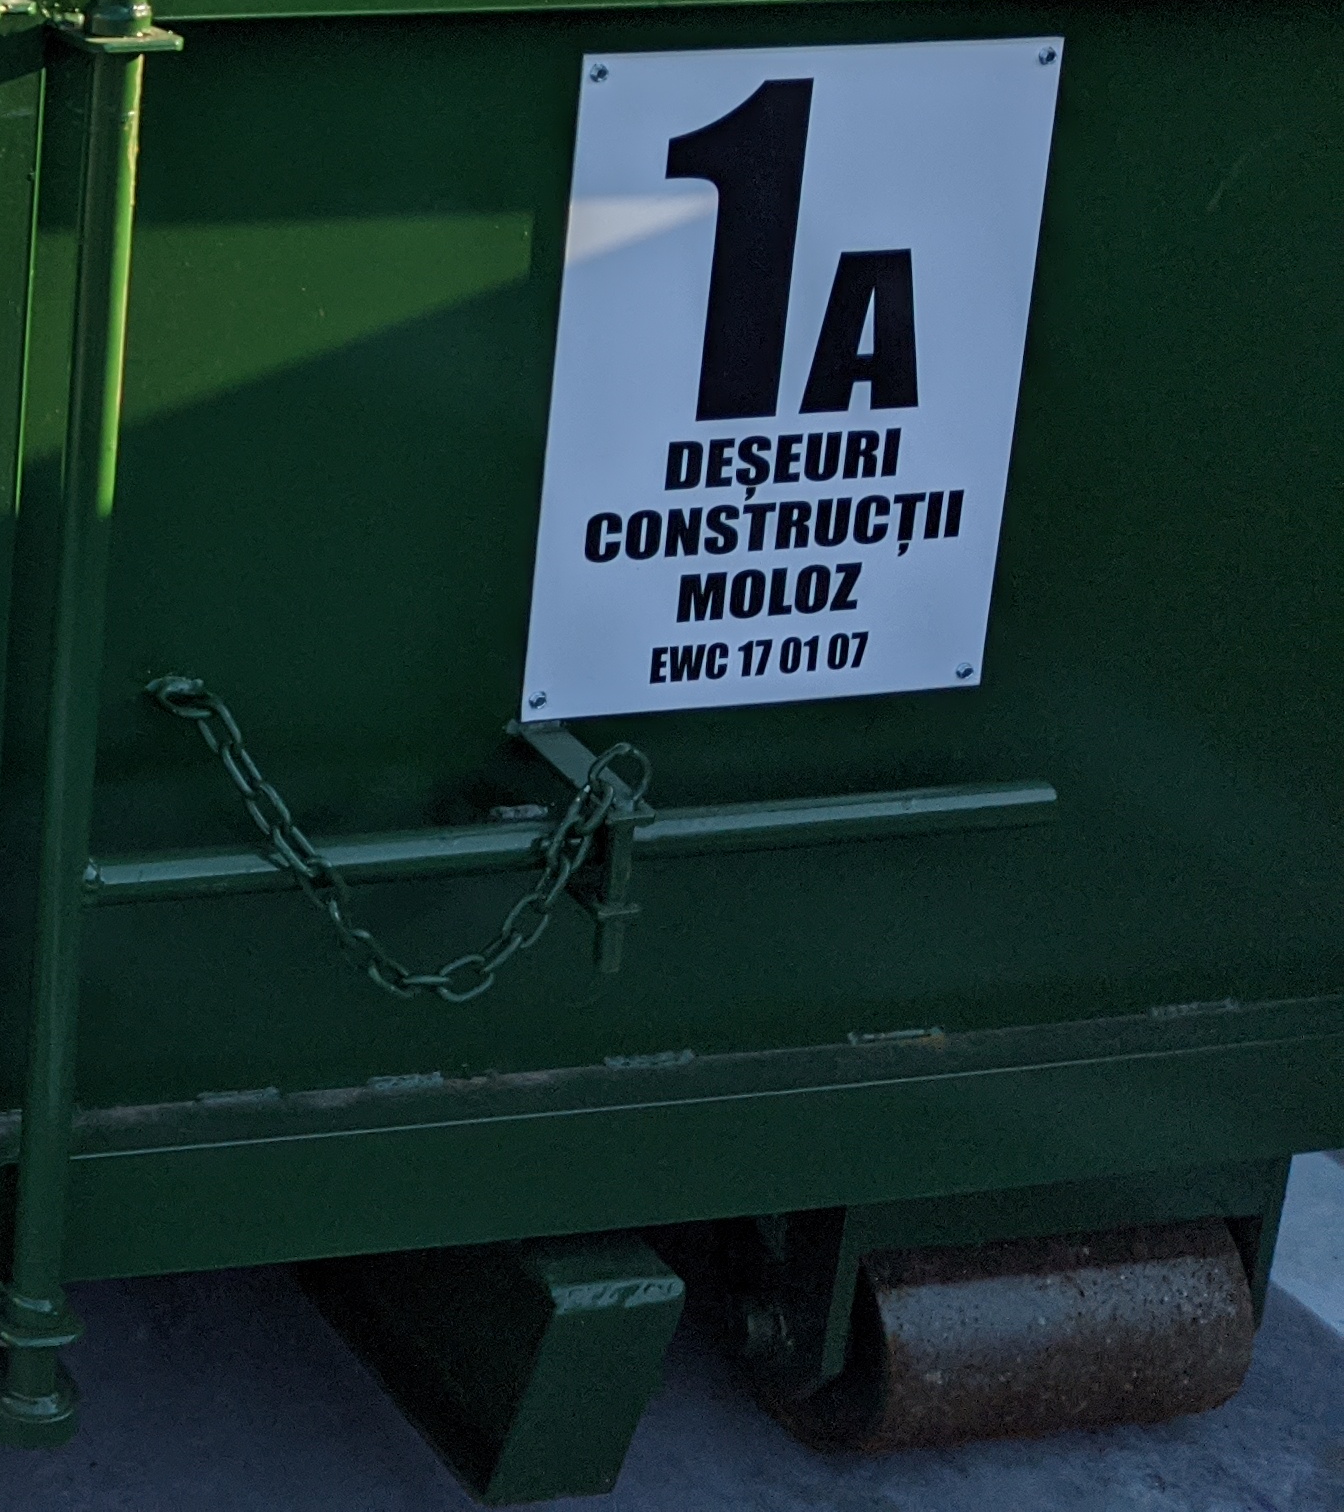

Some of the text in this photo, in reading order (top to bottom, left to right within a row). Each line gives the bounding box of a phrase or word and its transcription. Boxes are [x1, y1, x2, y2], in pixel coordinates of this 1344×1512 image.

[664, 427, 902, 501] DEȘEURI
[584, 489, 965, 563] CONSTRUCȚII
[675, 562, 863, 623] MOLOZ
[649, 631, 869, 684] EWC 17 01 07
